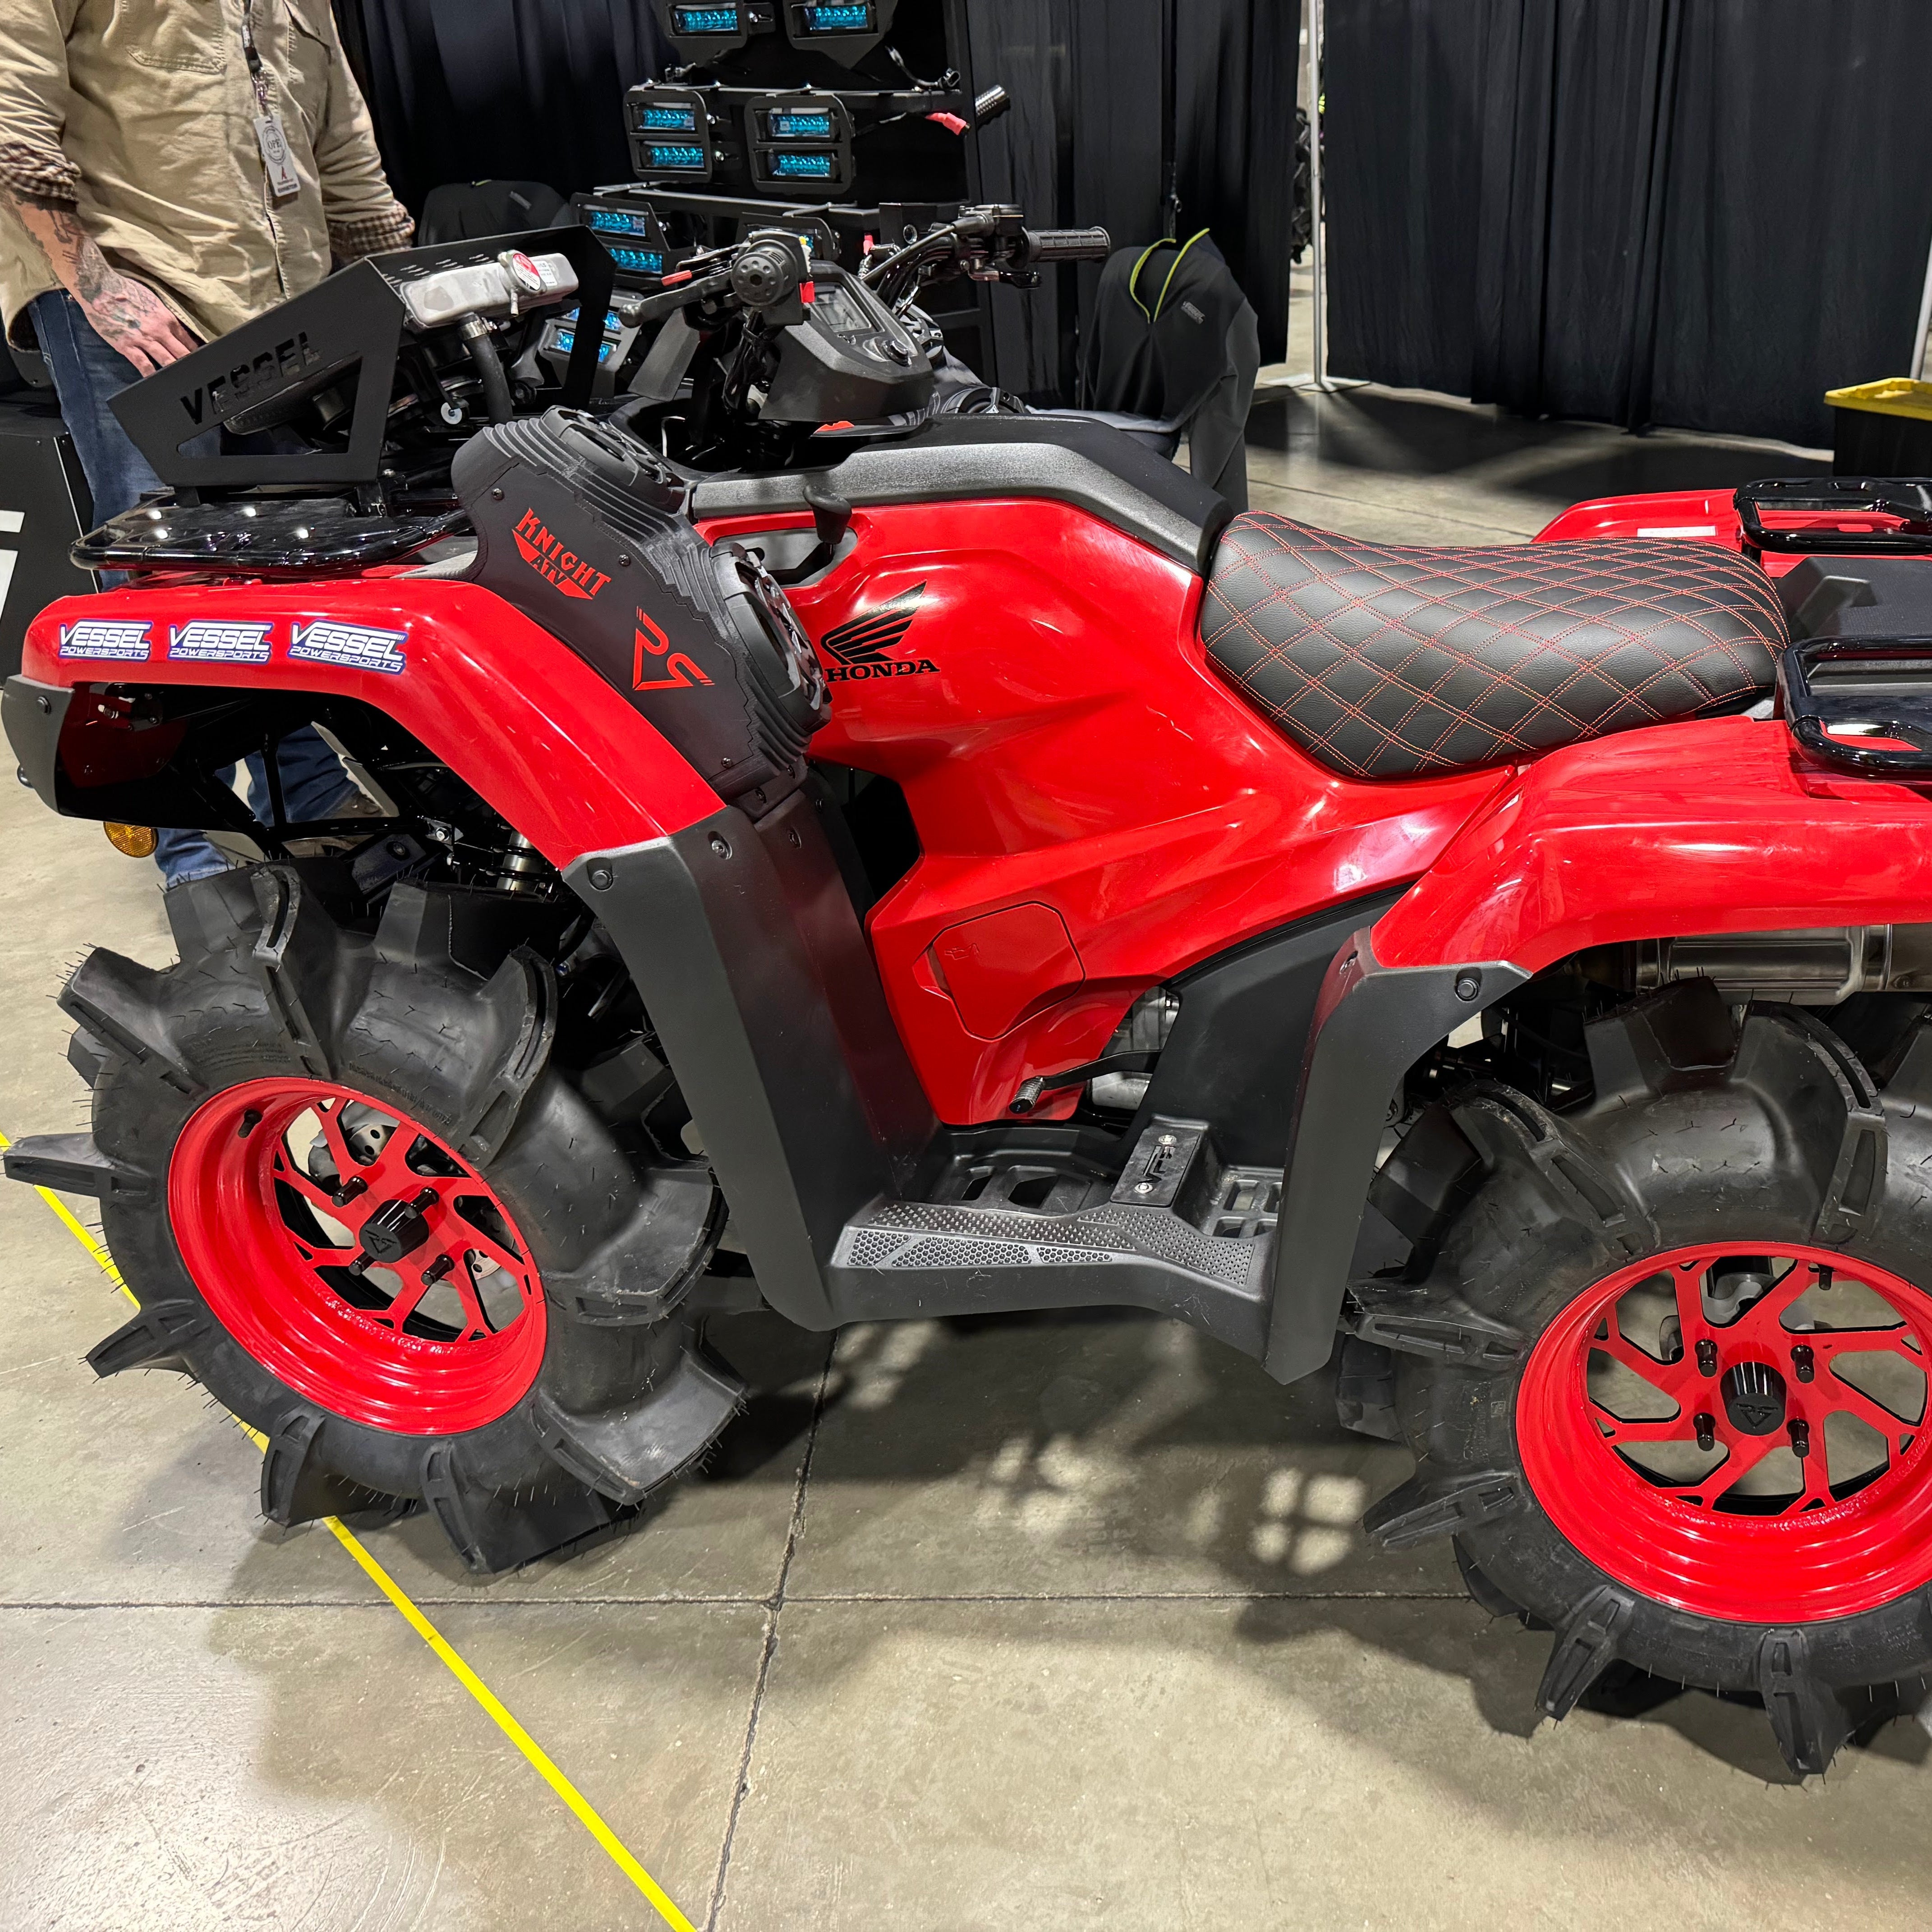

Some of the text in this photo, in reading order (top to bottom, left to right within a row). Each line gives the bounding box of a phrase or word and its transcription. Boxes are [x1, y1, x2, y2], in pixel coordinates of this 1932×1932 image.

[180, 331, 322, 425] VESSEL
[515, 507, 612, 596] KNIGHT
[529, 554, 568, 586] ATV
[60, 621, 151, 649] VESSEL
[170, 622, 272, 651] VESSEL
[292, 621, 405, 661] VESSEL
[60, 646, 149, 659] POWERSPORTS
[170, 648, 270, 662] POWERSPORTS
[290, 646, 403, 672] POWERSPORTS
[824, 659, 940, 683] HONDA
